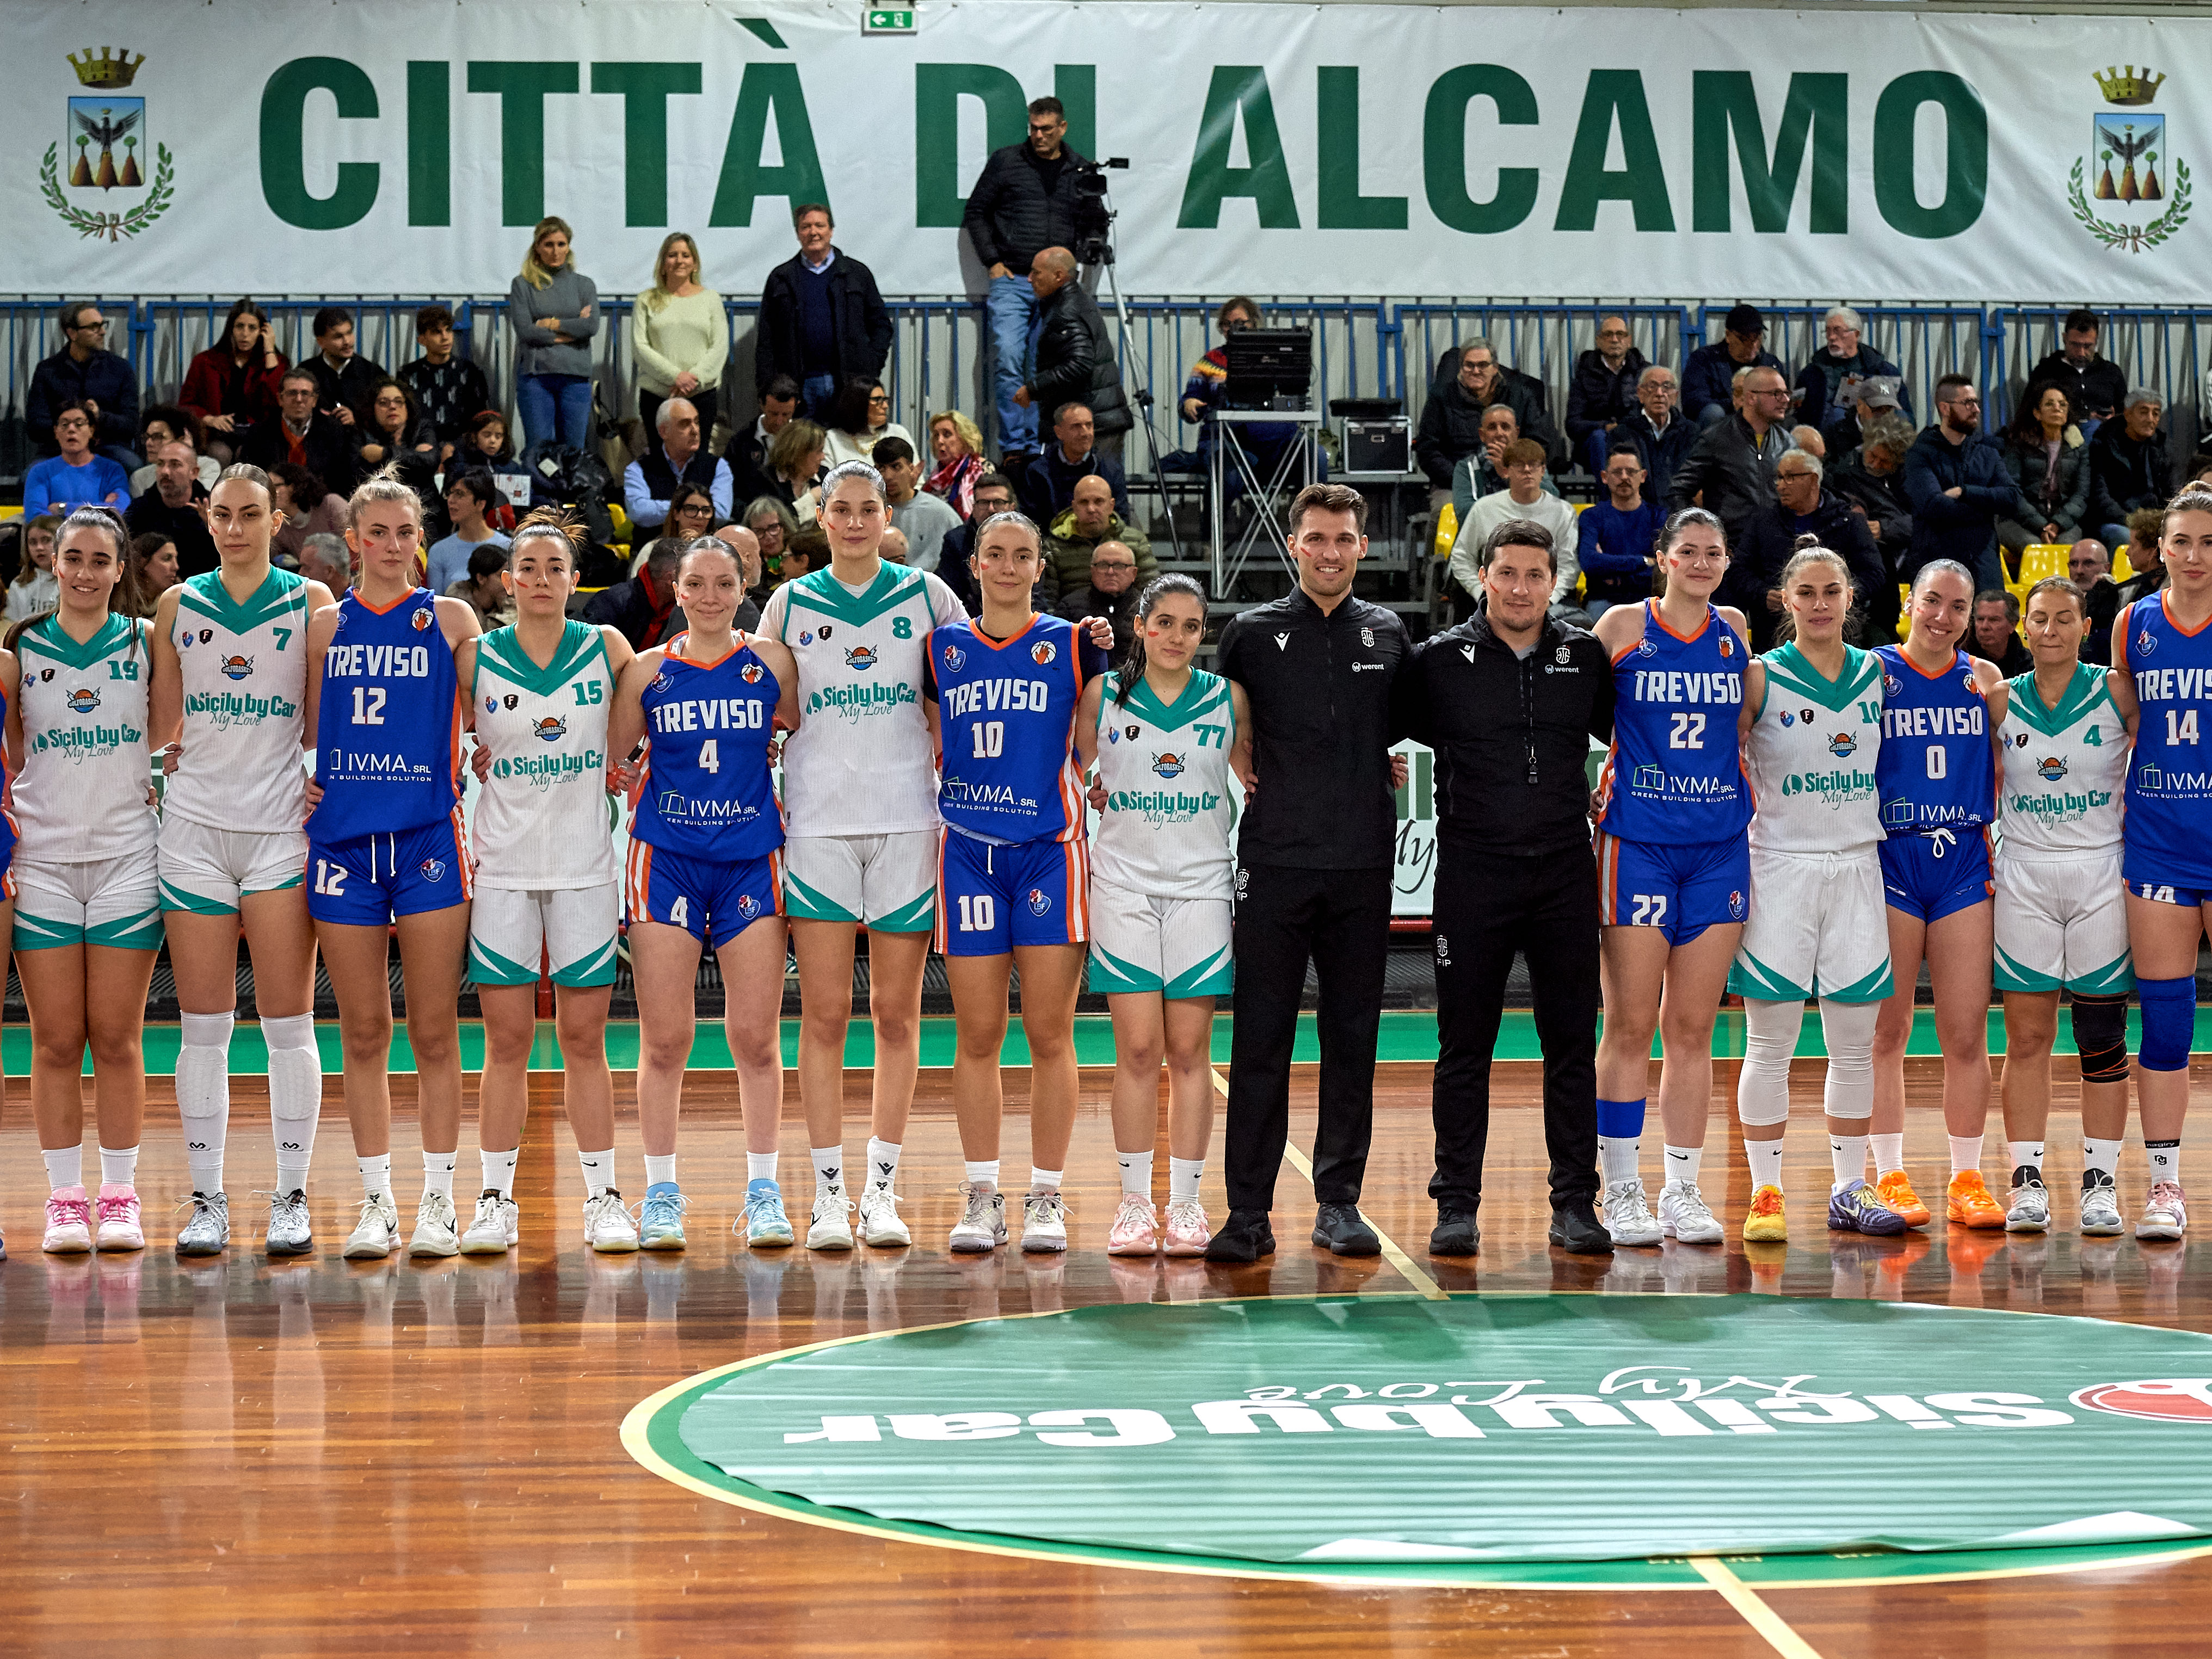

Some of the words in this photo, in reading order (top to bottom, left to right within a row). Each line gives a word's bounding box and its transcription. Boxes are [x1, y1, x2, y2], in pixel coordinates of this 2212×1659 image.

[259, 18, 830, 231] CITTÀ
[916, 63, 1096, 227] DI
[1176, 63, 1988, 239] ALCAMO
[273, 627, 292, 651] 7
[892, 616, 912, 639] 8
[108, 660, 138, 681] 19
[327, 645, 428, 678] TREVISO
[572, 680, 602, 706] 15
[823, 683, 871, 707] Sicily
[873, 682, 897, 706] by
[897, 682, 917, 704] Ca
[945, 679, 1048, 720] TREVISO
[1634, 670, 1742, 704] TREVISO
[245, 693, 268, 718] by
[270, 695, 296, 718] Car
[352, 687, 386, 724] 12
[652, 699, 762, 733] TREVISO
[837, 704, 860, 724] My
[864, 702, 892, 716] Love
[210, 712, 229, 731] My
[233, 712, 261, 725] Love
[1670, 713, 1706, 749] 22
[1881, 706, 1982, 739] TREVISO
[2166, 710, 2199, 745] 14
[48, 727, 94, 748] Sicily
[96, 725, 119, 746] by
[121, 724, 141, 743] Car
[971, 721, 1004, 758] 10
[1193, 724, 1226, 749] 77
[2083, 725, 2102, 747] 4
[63, 745, 84, 765] My
[87, 744, 114, 757] Love
[513, 755, 559, 776] Sicily
[562, 753, 583, 774] by
[585, 750, 603, 768] Ca
[699, 739, 719, 773] 4
[1926, 745, 1946, 779] 0
[414, 765, 431, 773] SRL
[529, 773, 550, 792] My
[553, 770, 578, 784] Love
[1805, 770, 1851, 793] Sicily
[1852, 769, 1875, 791] by
[1631, 791, 1659, 799] GREEN
[1721, 785, 1735, 793] SRL
[1820, 789, 1841, 810] My
[1845, 788, 1871, 801] Love
[2065, 792, 2087, 812] by
[2088, 790, 2111, 807] Car
[956, 803, 990, 811] BUILDING
[994, 806, 1037, 816] SOLUTION
[1020, 798, 1038, 808] SRL
[1129, 791, 1175, 815] Sicily
[1178, 792, 1200, 814] by
[1201, 791, 1221, 811] Car
[1143, 810, 1164, 830] My
[1167, 810, 1193, 823] Love
[2035, 812, 2054, 830] My
[2058, 810, 2084, 823] Love
[315, 859, 348, 897] 12
[670, 896, 688, 928] 4
[958, 896, 995, 931] 10
[1632, 894, 1667, 926] 22
[1437, 959, 1451, 967] FIP
[1244, 1379, 1545, 1405] Love
[1192, 1398, 1487, 1438] by
[1492, 1392, 2075, 1437] Sicily
[784, 1409, 1177, 1447] Car
